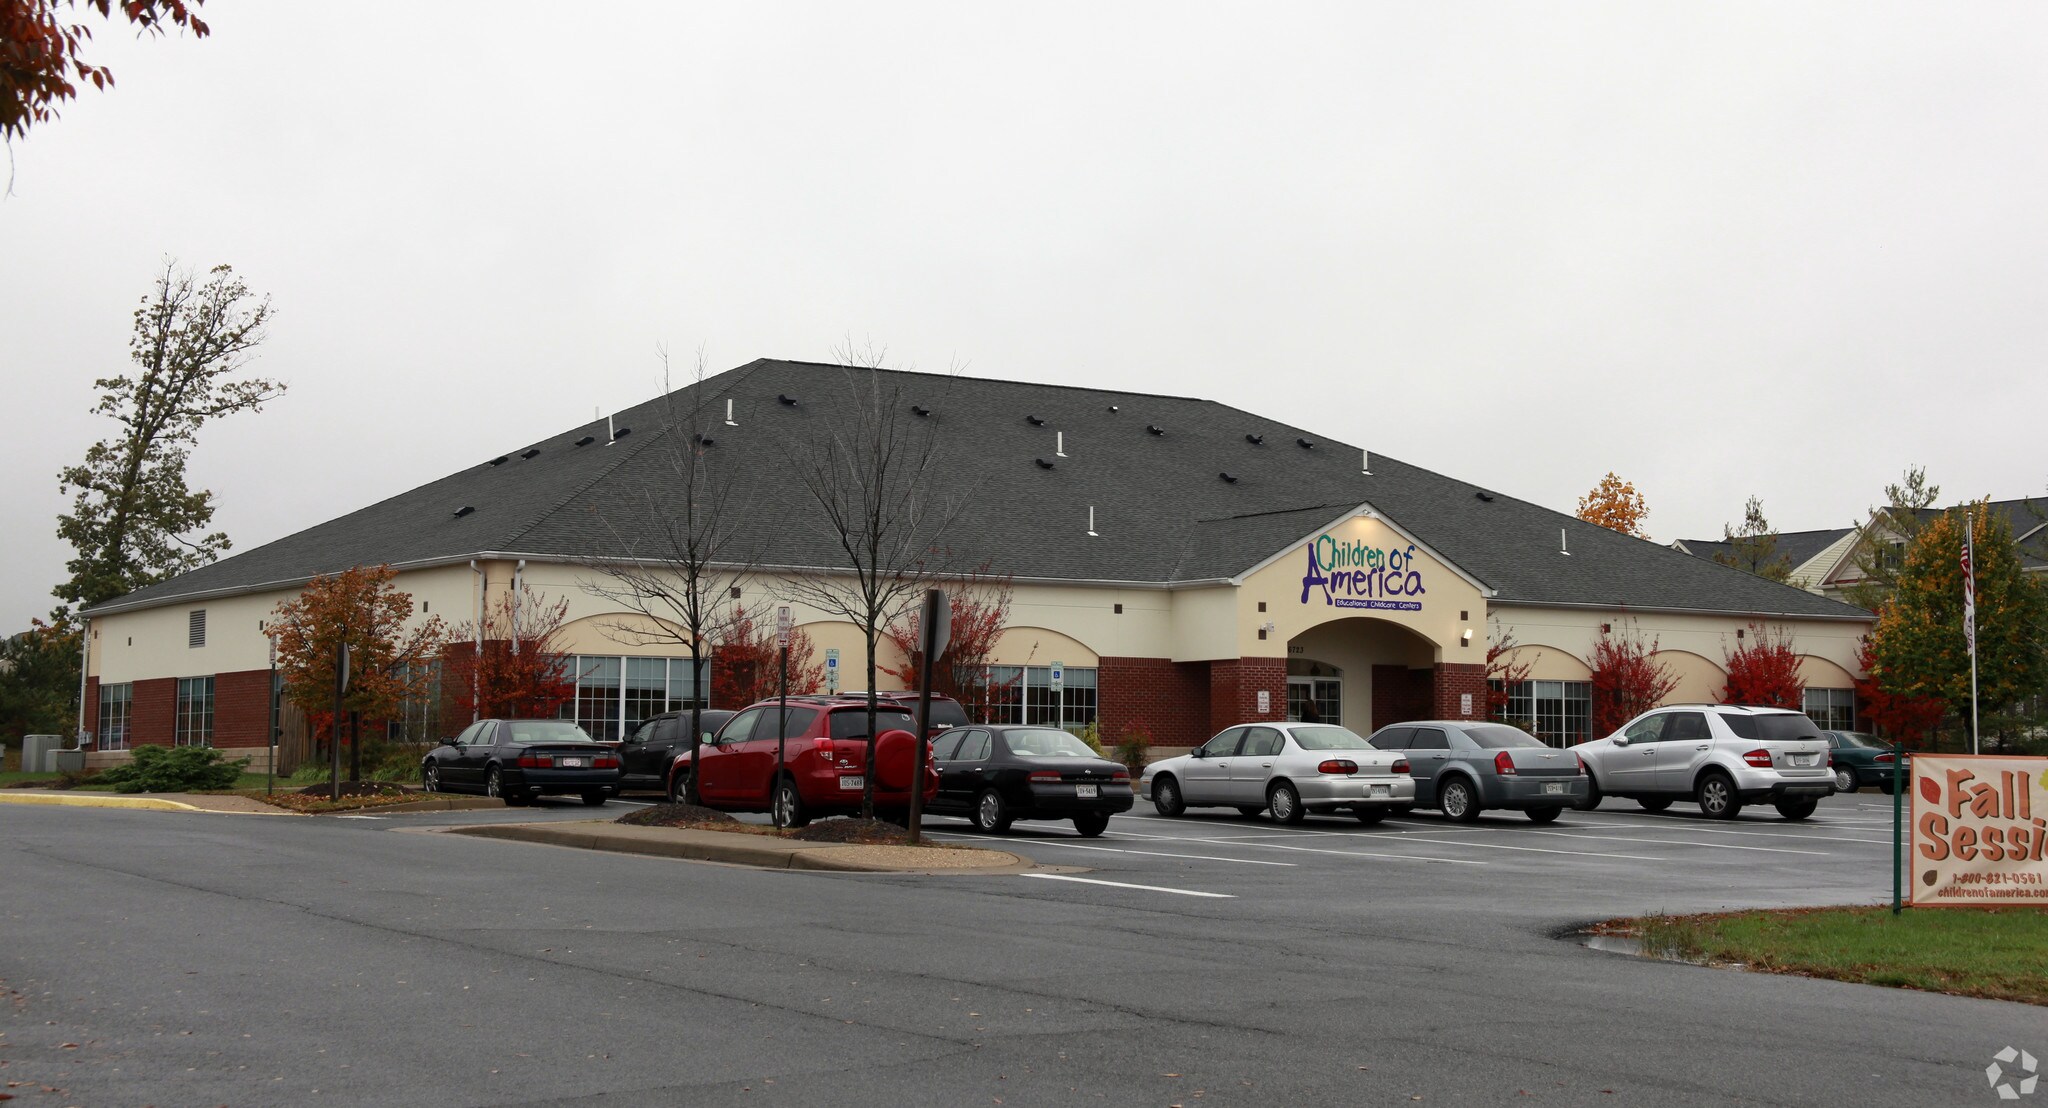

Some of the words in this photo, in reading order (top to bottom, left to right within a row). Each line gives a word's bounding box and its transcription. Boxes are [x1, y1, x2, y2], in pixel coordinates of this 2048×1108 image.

[1316, 534, 1385, 572] Children
[1389, 545, 1416, 572] of
[1301, 542, 1426, 605] America
[1336, 599, 1368, 608] Educational
[1370, 600, 1397, 609] Childcare
[1398, 601, 1420, 610] Centers
[1287, 646, 1304, 654] 6723
[1946, 768, 2031, 820] Fall
[1918, 811, 2048, 862] Sessi
[1952, 872, 2043, 885] 1-800-821-0561
